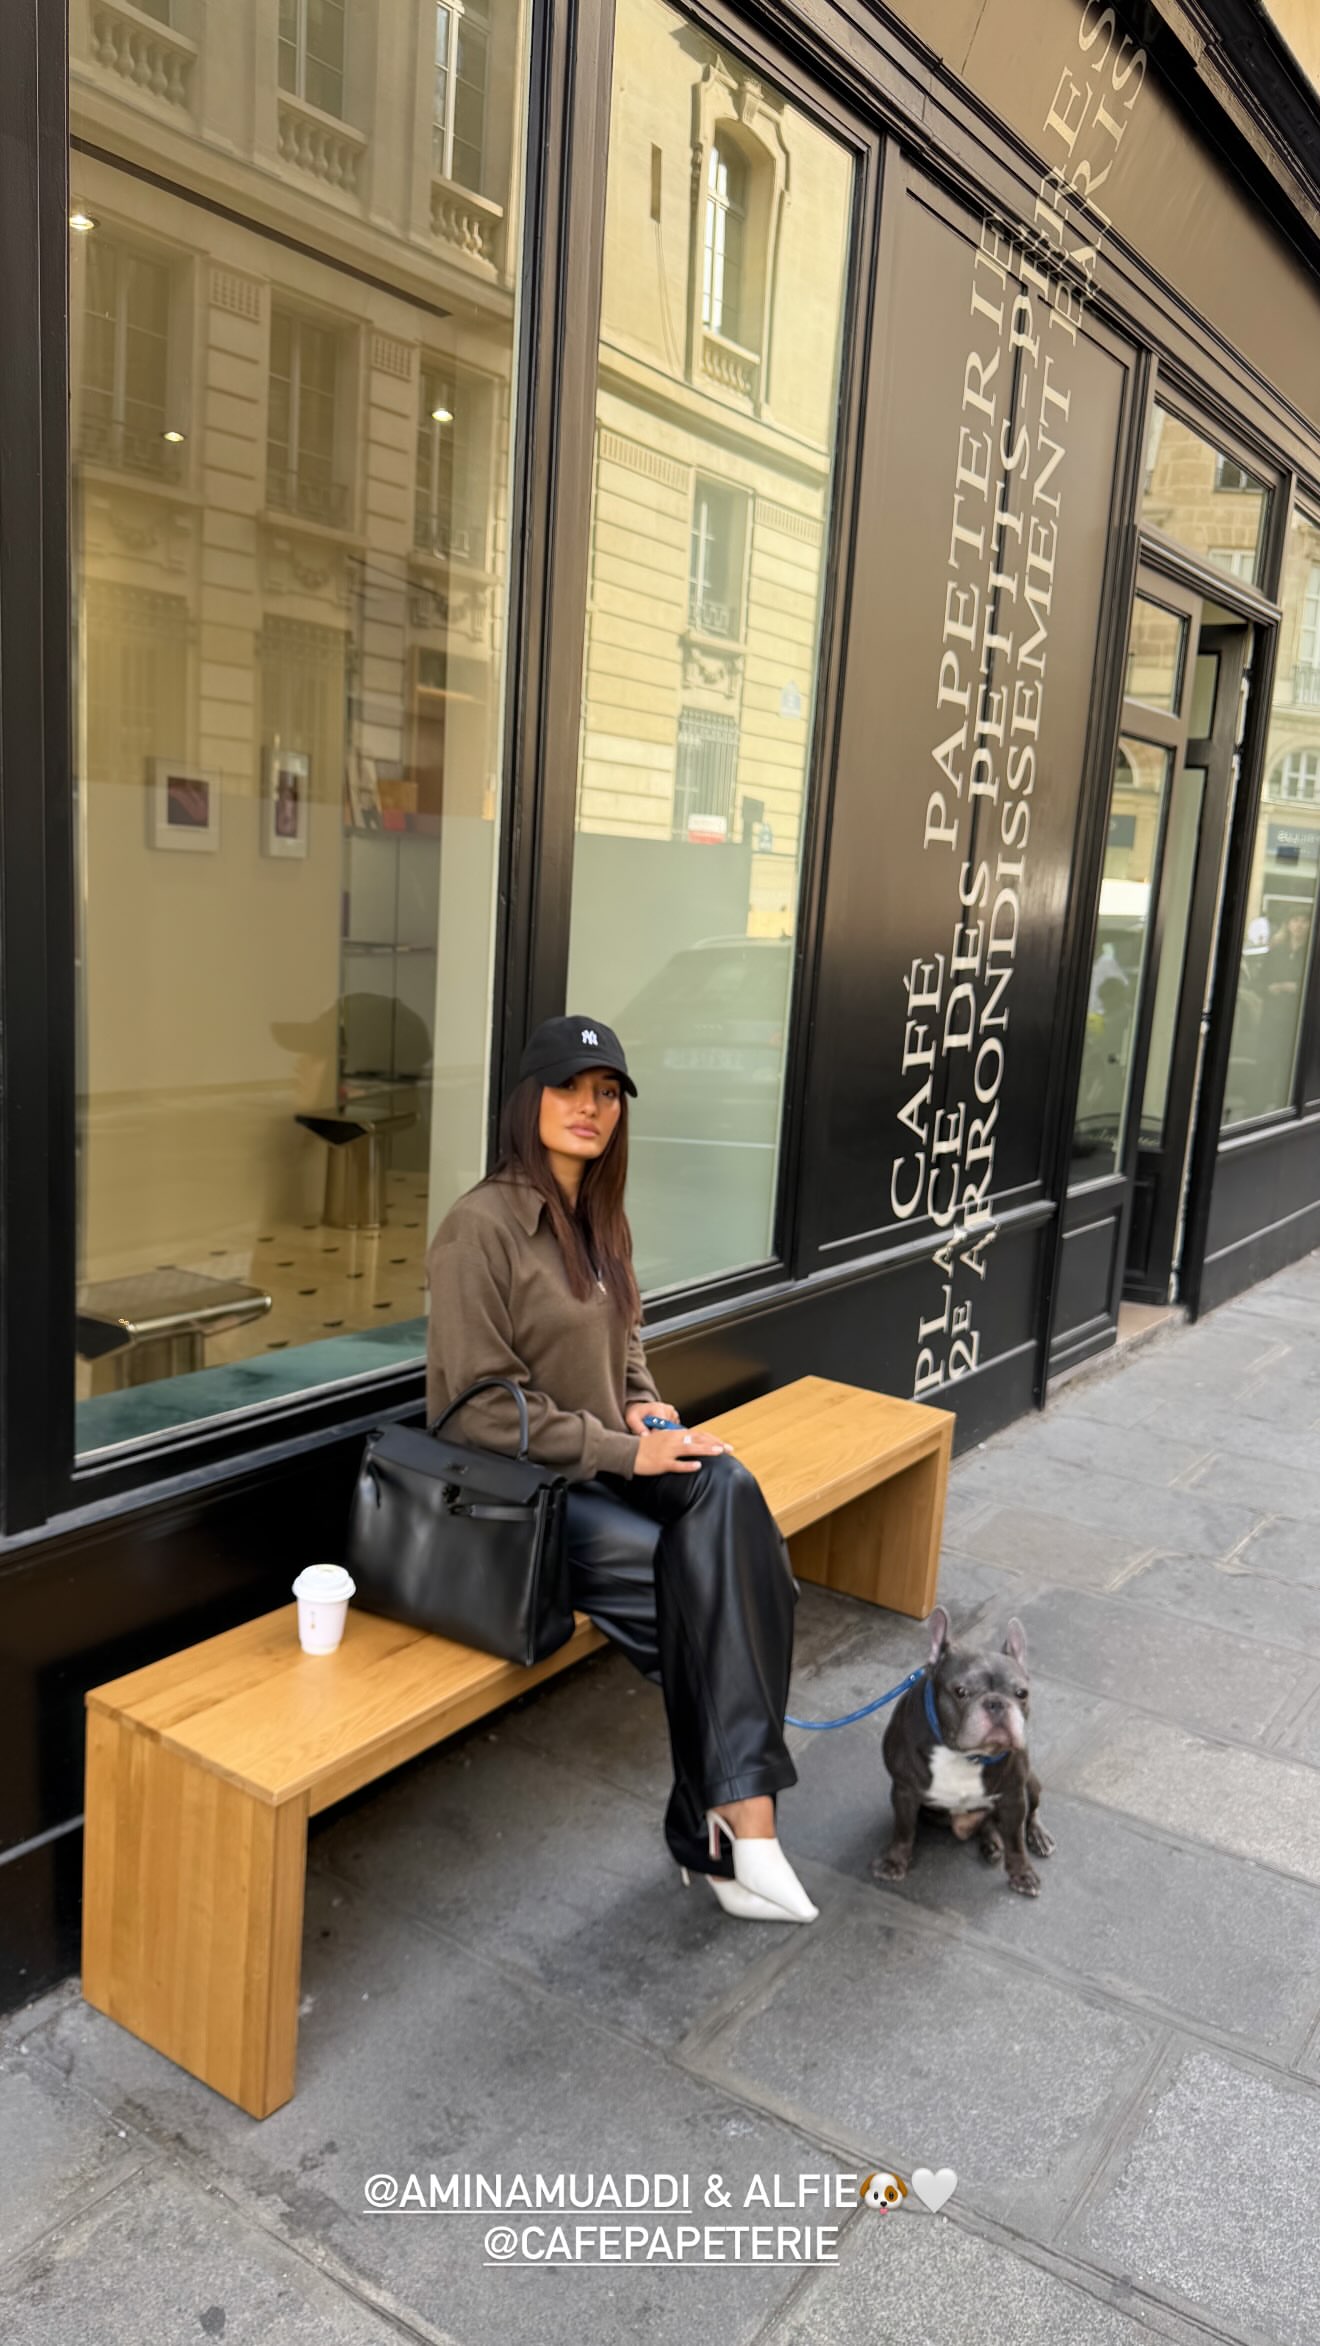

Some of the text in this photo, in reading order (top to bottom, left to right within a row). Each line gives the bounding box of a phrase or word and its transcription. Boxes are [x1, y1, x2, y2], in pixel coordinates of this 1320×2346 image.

[890, 213, 1028, 1219] CAFÉ PAPETERIE
[913, 1100, 967, 1400] PLACE
[941, 861, 990, 1057] DES
[960, 356, 1072, 1281] ARRONDISSEMENT
[1049, 33, 1147, 347] PARIS
